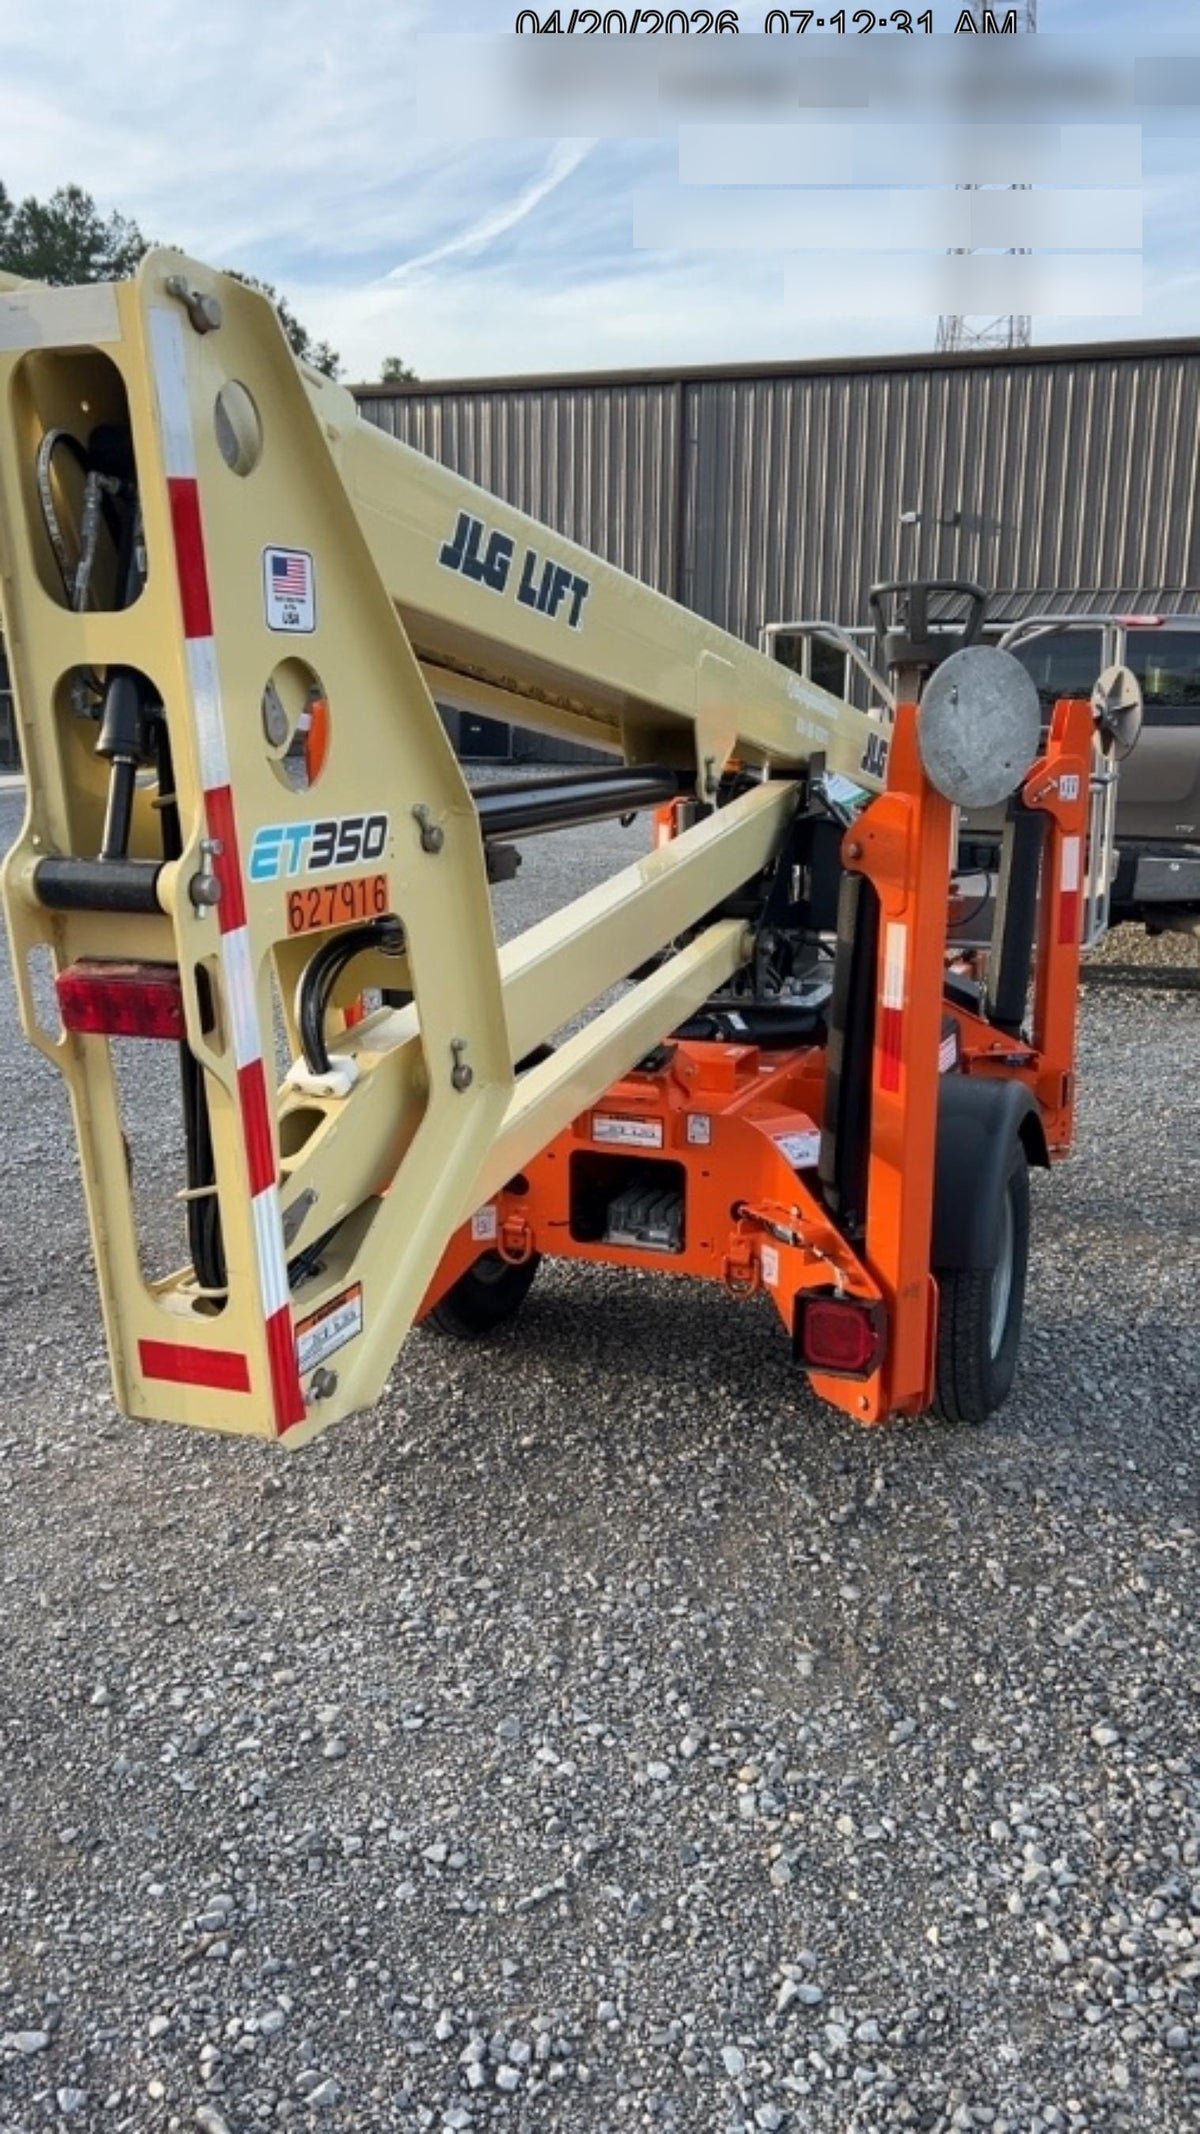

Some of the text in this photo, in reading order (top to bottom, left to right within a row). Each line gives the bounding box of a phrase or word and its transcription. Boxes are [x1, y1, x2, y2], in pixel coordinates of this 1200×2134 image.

[439, 511, 590, 628] JLG LIFT
[250, 815, 387, 879] ET350
[289, 874, 386, 932] 627916
